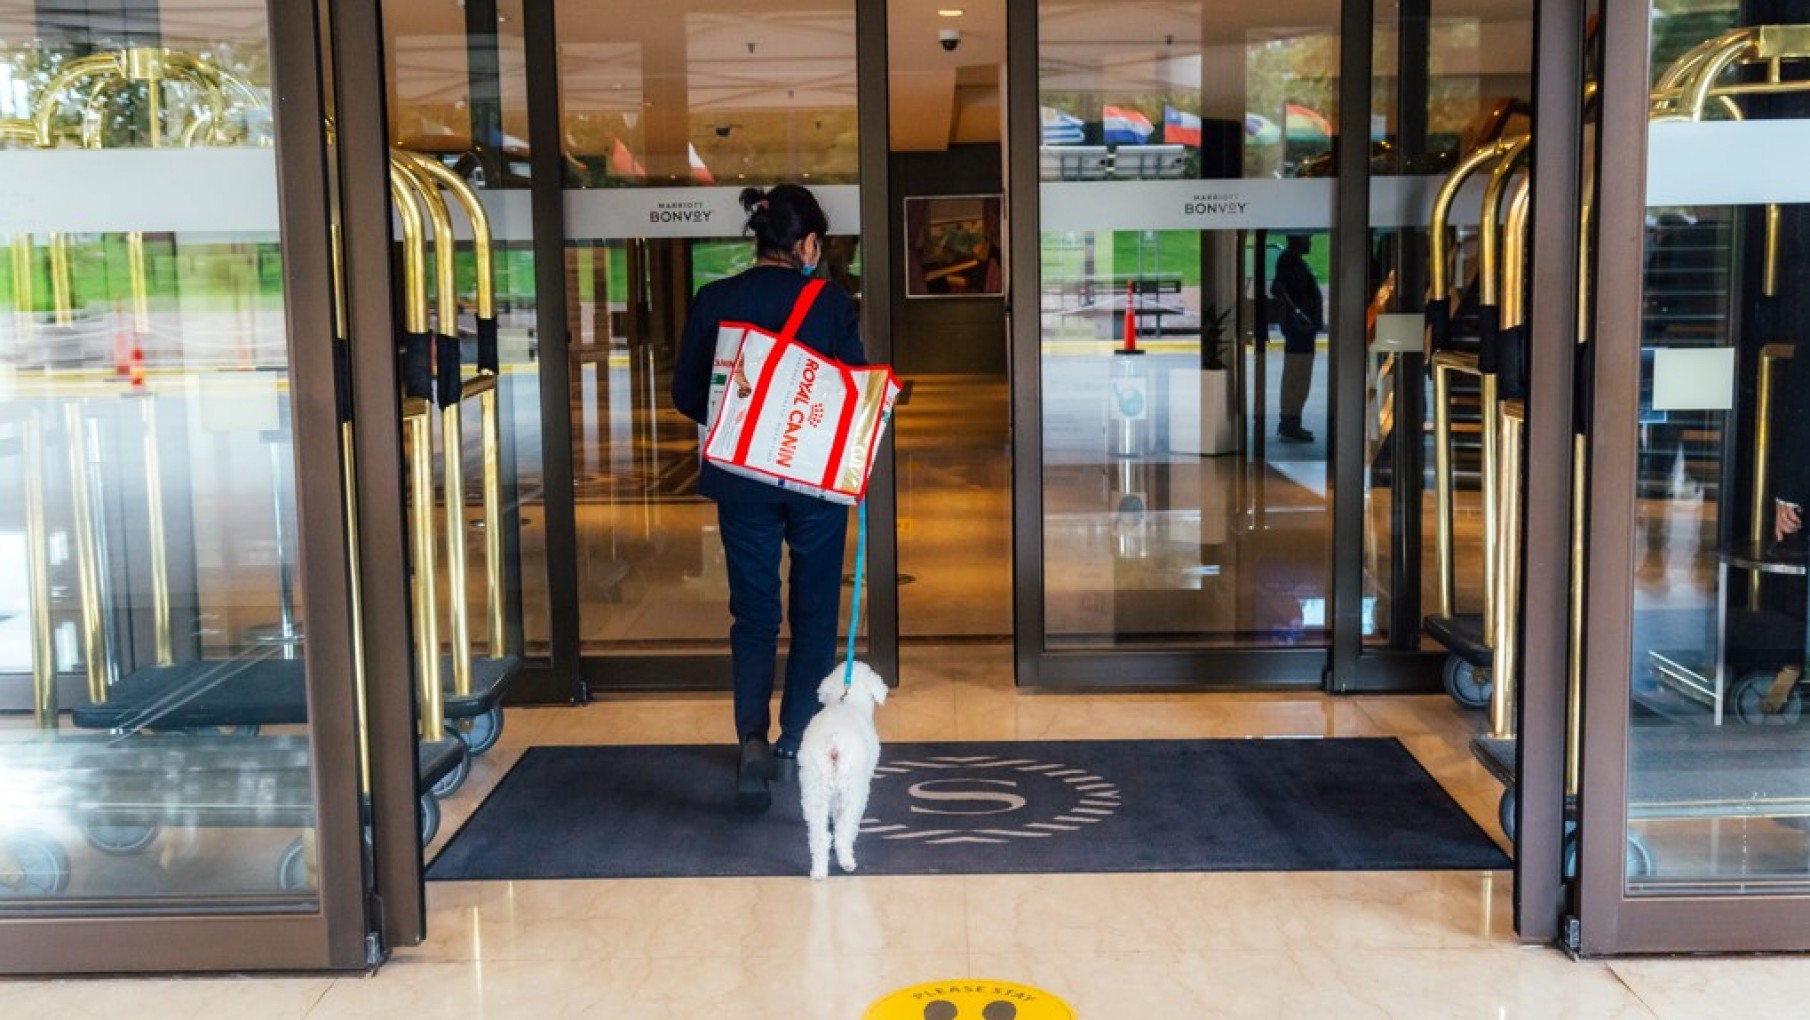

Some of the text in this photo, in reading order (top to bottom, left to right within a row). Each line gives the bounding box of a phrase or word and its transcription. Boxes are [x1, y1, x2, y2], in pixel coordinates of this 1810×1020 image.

[650, 211, 711, 223] BONVOY
[1184, 202, 1247, 215] BONVOY
[794, 358, 819, 405] ROYAL
[776, 409, 805, 468] CANIN
[907, 778, 1027, 815] S
[912, 985, 1038, 1002] PLEASE STAY
